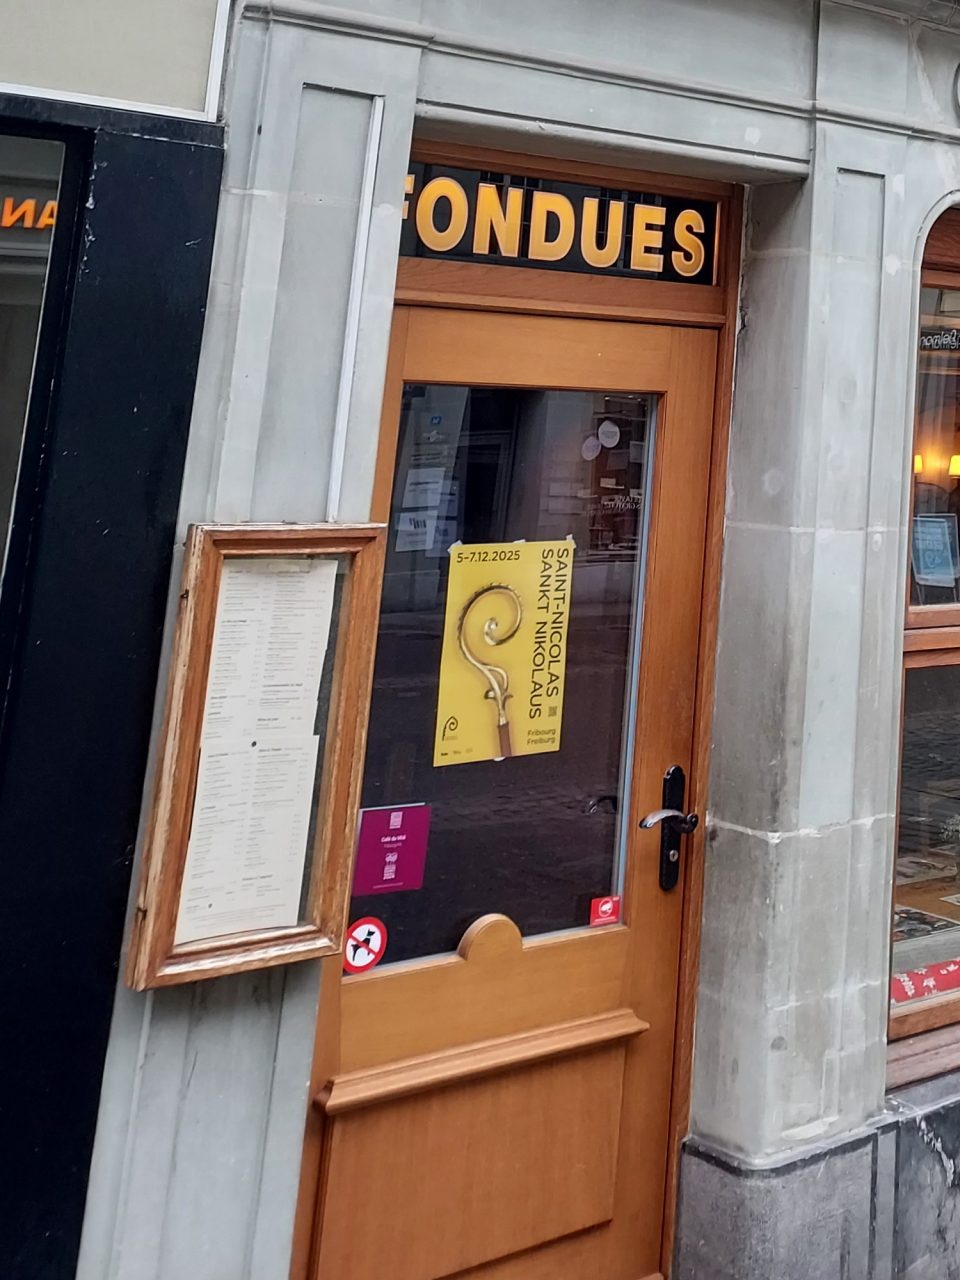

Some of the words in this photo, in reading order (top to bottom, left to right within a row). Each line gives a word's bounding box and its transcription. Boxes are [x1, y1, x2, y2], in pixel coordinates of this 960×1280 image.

[537, 548, 554, 613] SANKT
[546, 548, 570, 698] SAINT-NICOLAS
[529, 622, 546, 719] NIKOLAUS
